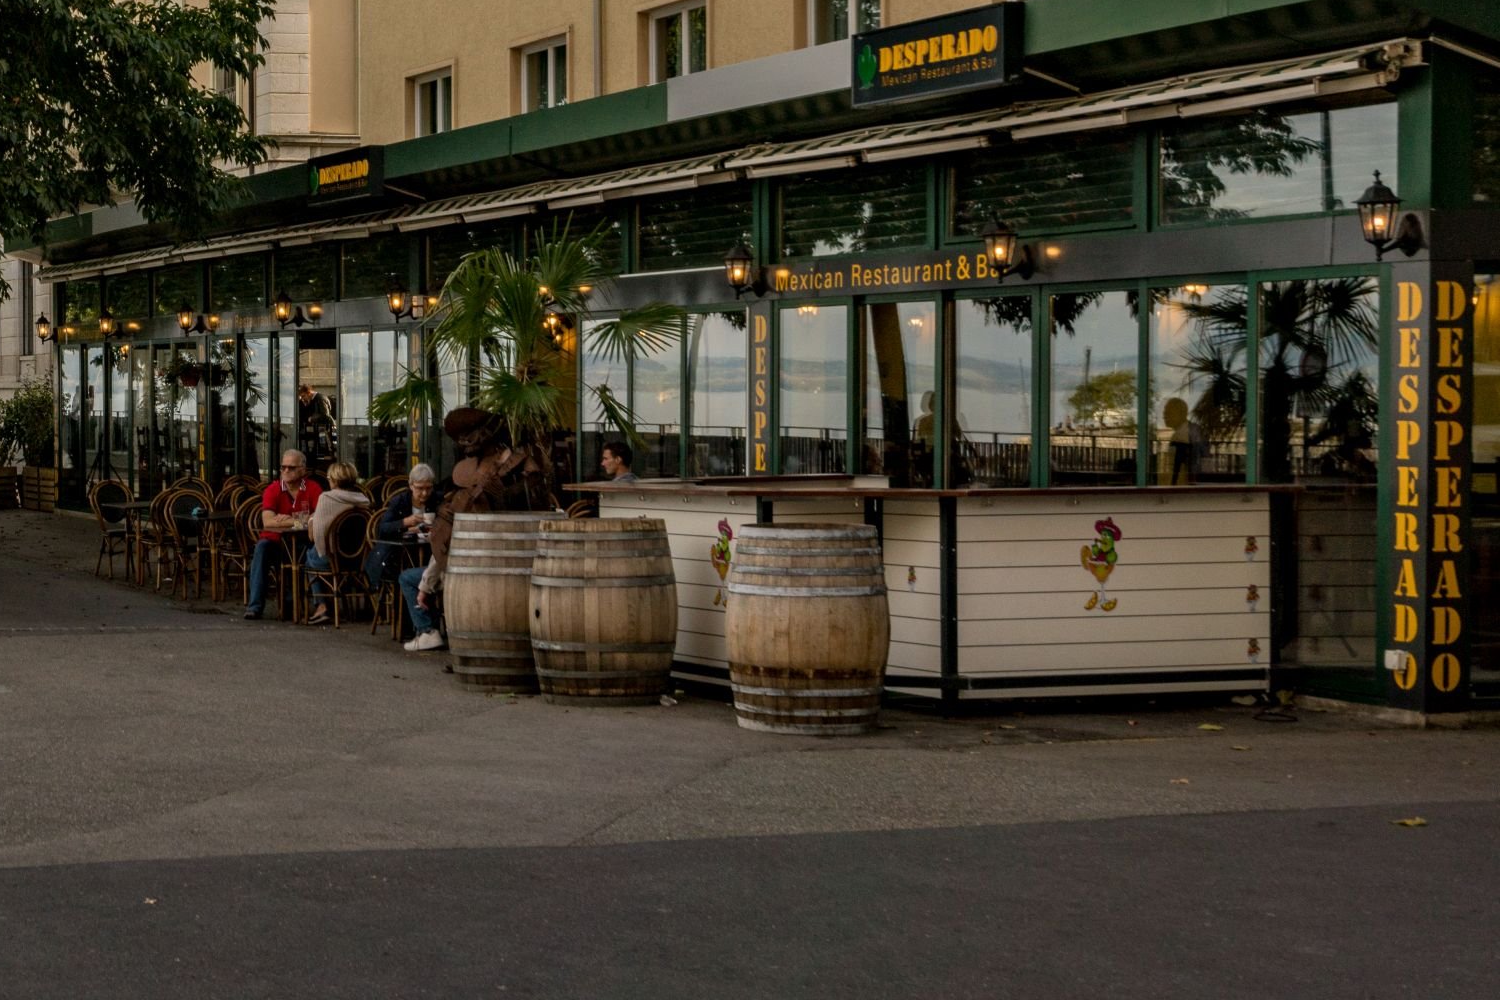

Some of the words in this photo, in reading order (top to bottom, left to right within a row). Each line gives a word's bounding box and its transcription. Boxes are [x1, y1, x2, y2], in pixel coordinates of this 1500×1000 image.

[878, 24, 998, 73] DESPERADO
[882, 73, 917, 87] Mexican
[921, 63, 971, 79] Restaurant
[972, 59, 979, 71] &
[981, 57, 997, 69] Bar
[319, 159, 369, 185] DESPERADO
[775, 266, 844, 292] Mexican
[851, 258, 953, 287] Restaurant
[956, 254, 971, 280] &
[1394, 281, 1423, 692] DESPERADO
[1432, 281, 1466, 691] DESPERADO
